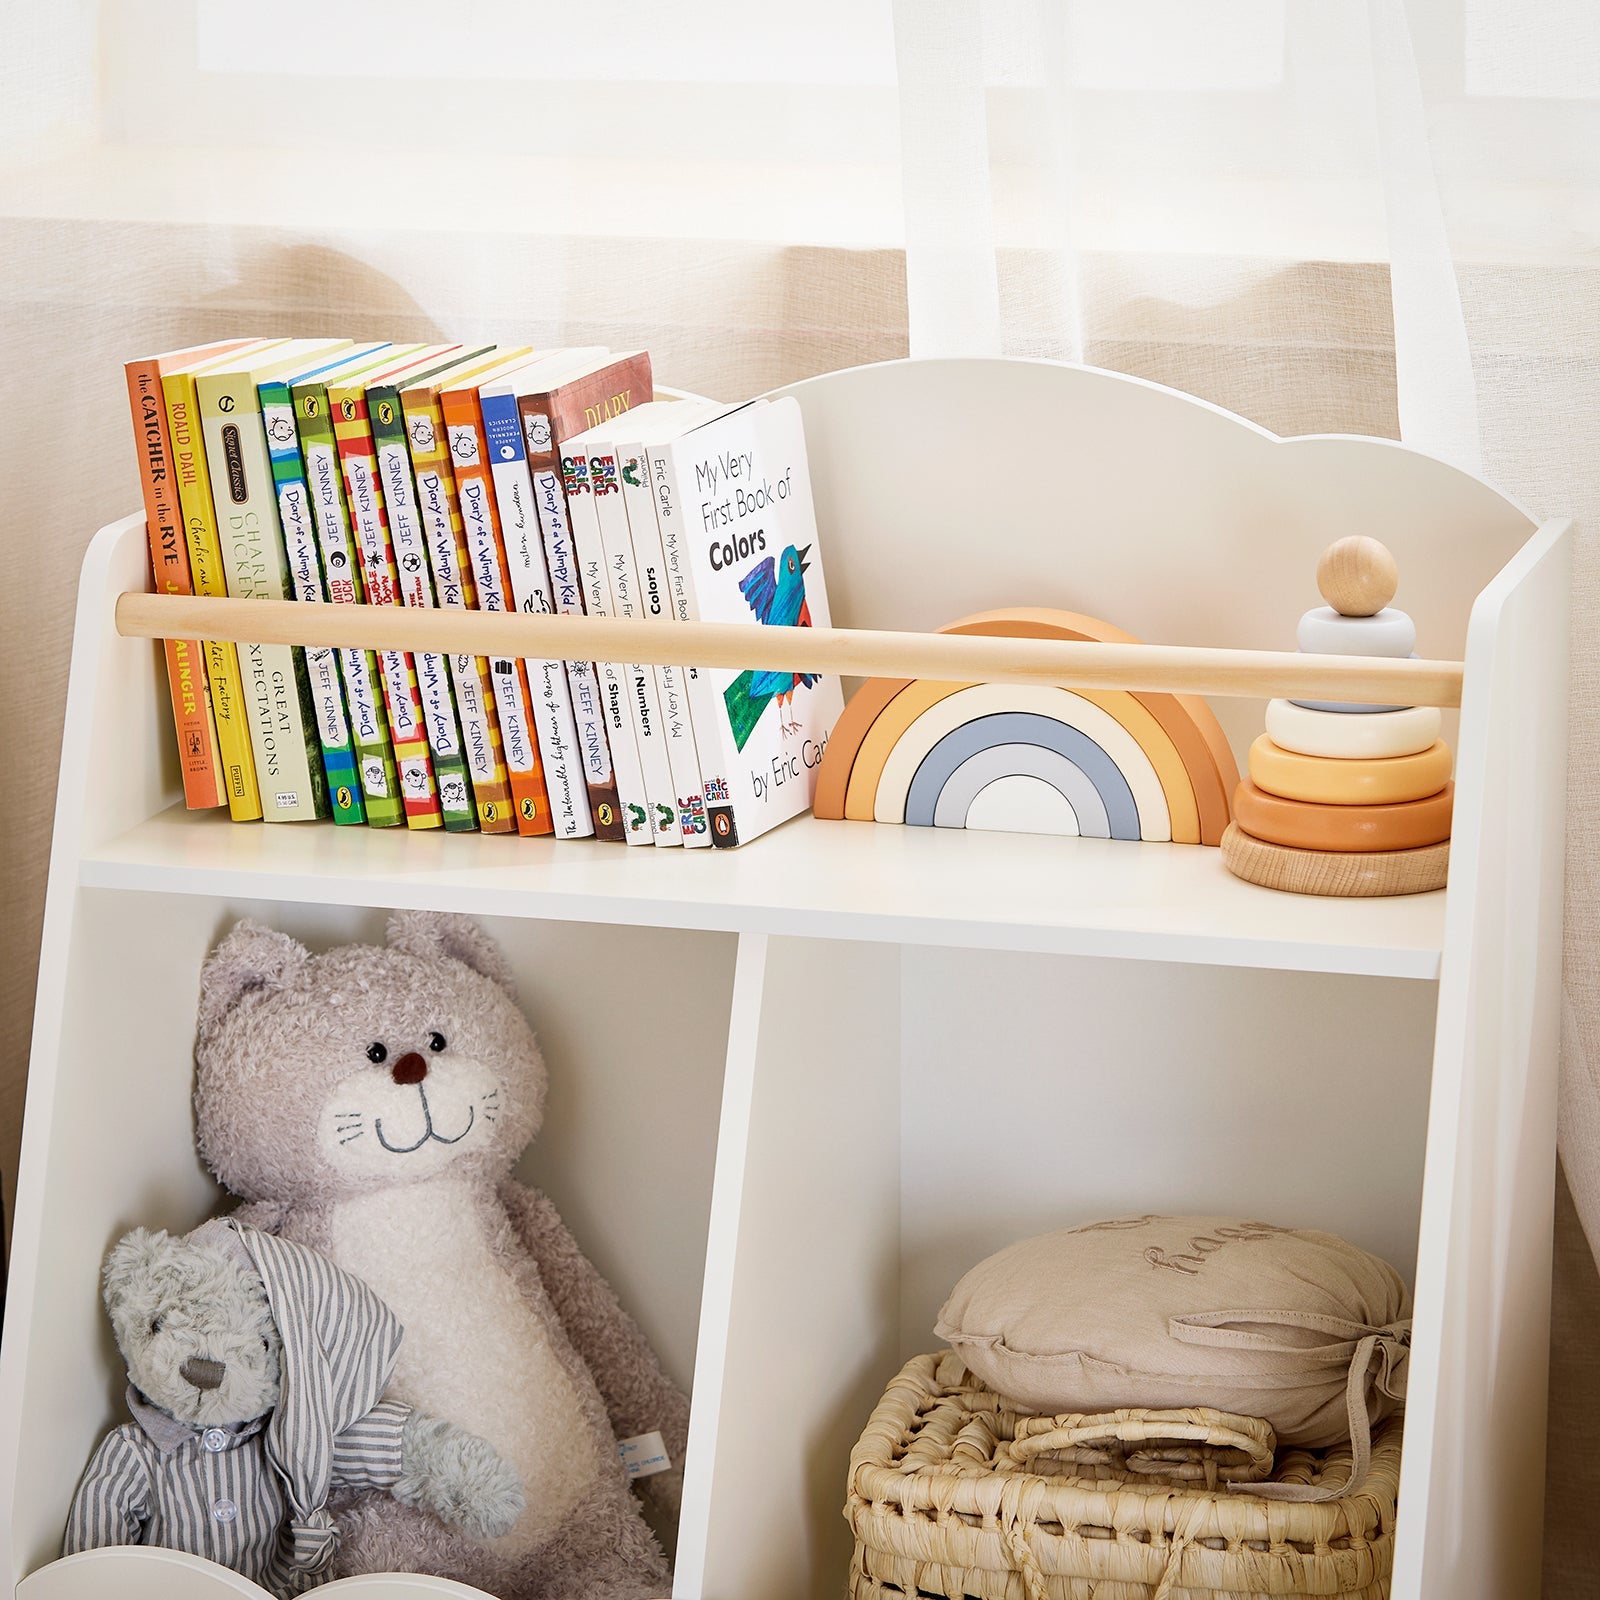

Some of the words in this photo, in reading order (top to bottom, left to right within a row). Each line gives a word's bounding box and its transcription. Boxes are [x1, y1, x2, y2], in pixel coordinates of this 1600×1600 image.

[138, 374, 152, 393] the
[172, 403, 191, 445] ROALD
[488, 418, 517, 426] CLASSICS
[488, 431, 520, 439] PERENNIAL
[141, 395, 166, 483] CATCHER
[225, 427, 238, 459] Signet
[180, 452, 197, 487] DAHL
[230, 460, 244, 500] Classics
[316, 454, 334, 505] KINNEY
[387, 453, 406, 507] KINNEY
[562, 457, 579, 496] CARLE
[590, 457, 607, 496] CARLE
[642, 454, 651, 489] Philomel
[654, 459, 666, 481] Eric
[695, 460, 718, 496] My
[718, 451, 753, 482] Very
[155, 487, 165, 498] in
[354, 464, 371, 512] KINNEY
[423, 475, 442, 514] Diary
[465, 485, 484, 523] Diary
[540, 475, 559, 515] Diary
[659, 485, 673, 517] Carle
[701, 498, 734, 533] First
[735, 478, 775, 518] Book
[777, 467, 792, 500] of
[157, 503, 171, 523] the
[286, 490, 302, 524] Diary
[436, 517, 445, 528] of
[552, 518, 562, 528] of
[296, 526, 305, 536] of
[325, 512, 340, 543] JEFF
[363, 519, 377, 548] JEFF
[398, 514, 412, 546] JEFF
[477, 526, 487, 537] of
[666, 534, 677, 549] My
[160, 526, 179, 566] RYE
[190, 517, 209, 563] Charlie
[200, 569, 210, 586] and
[230, 516, 254, 599] DICKEN
[245, 512, 270, 599] CHARLE
[437, 539, 452, 582] Wimpy
[520, 533, 531, 568] milan
[553, 540, 568, 583] Wimpy
[670, 550, 680, 573] Very
[709, 529, 766, 571] Colors
[297, 545, 310, 582] Wimpy
[478, 547, 493, 590] Wimpy
[587, 562, 599, 578] My
[614, 554, 625, 572] My
[303, 584, 316, 602] Kid
[342, 579, 355, 604] UCK
[381, 575, 393, 603] DOWN
[415, 577, 423, 601] STRAW
[444, 585, 459, 605] Kid
[485, 592, 501, 612] Kid
[560, 585, 576, 606] Kid
[592, 581, 602, 608] Very
[618, 573, 629, 601] Very
[646, 567, 661, 615] Colors
[674, 576, 684, 596] First
[623, 603, 633, 618] Fir
[175, 640, 196, 715] ALINGER
[319, 663, 331, 690] JEFF
[350, 648, 362, 677] Wim
[424, 653, 439, 689] Wimp
[606, 669, 617, 681] of
[663, 665, 674, 689] First
[355, 688, 363, 698] of
[393, 681, 401, 690] of
[502, 678, 516, 709] JEFF
[543, 662, 558, 699] Being
[213, 677, 231, 725] Factory
[249, 644, 280, 776] XPECTATIONS
[272, 671, 291, 734] GREAT
[395, 693, 412, 728] Diary
[430, 700, 439, 710] of
[462, 682, 477, 714] JEFF
[547, 701, 560, 713] of
[578, 683, 594, 715] JEFF
[608, 684, 622, 729] Shapes
[635, 676, 652, 737] Numbers
[668, 691, 679, 719] Very
[324, 697, 339, 742] KINNEY
[358, 701, 374, 737] Diary
[433, 713, 452, 751] Diary
[671, 721, 684, 738] My
[469, 721, 488, 774] KINNEY
[507, 715, 526, 766] KINNEY
[585, 723, 604, 776] KINNEY
[233, 767, 243, 794] PUFFIN
[751, 771, 768, 803] by
[771, 752, 800, 787] Eric
[802, 730, 829, 769] Car
[559, 764, 574, 819] Unbearable
[705, 791, 730, 802] CARLE
[565, 819, 577, 836] The
[690, 795, 707, 834] CARLE
